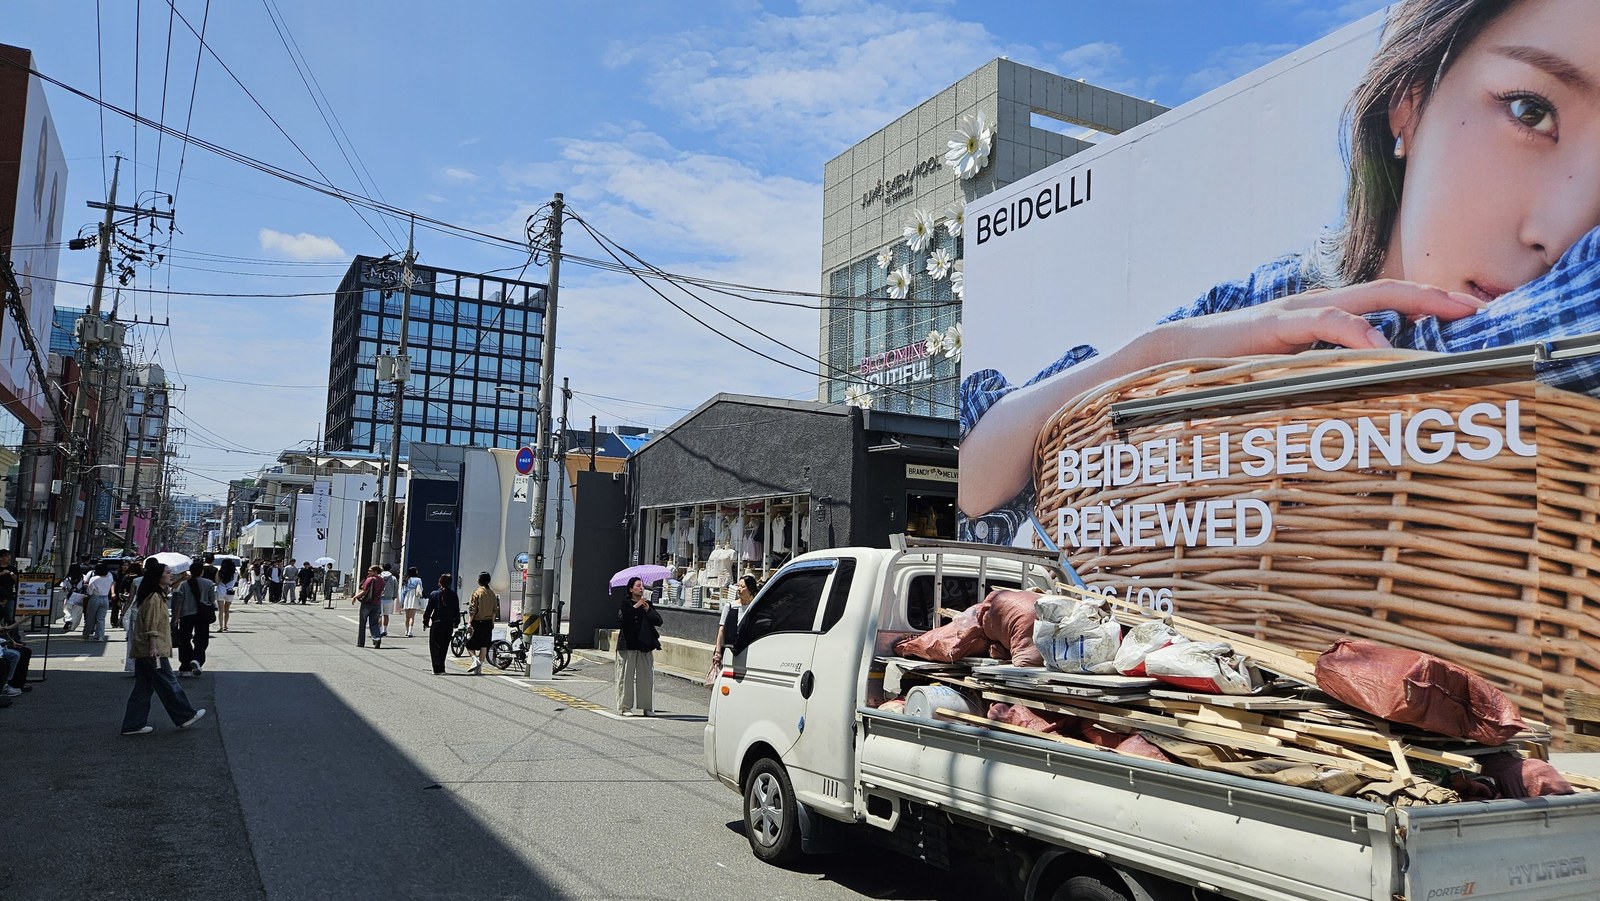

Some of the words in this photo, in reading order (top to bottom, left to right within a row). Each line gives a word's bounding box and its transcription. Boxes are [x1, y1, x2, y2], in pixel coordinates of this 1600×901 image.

[1058, 432, 1229, 490] BEIDELLI
[1240, 399, 1537, 477] SEONGSU
[908, 468, 930, 476] BRANDY
[1057, 498, 1273, 547] RENEWED
[1507, 856, 1588, 886] HYUNDAI
